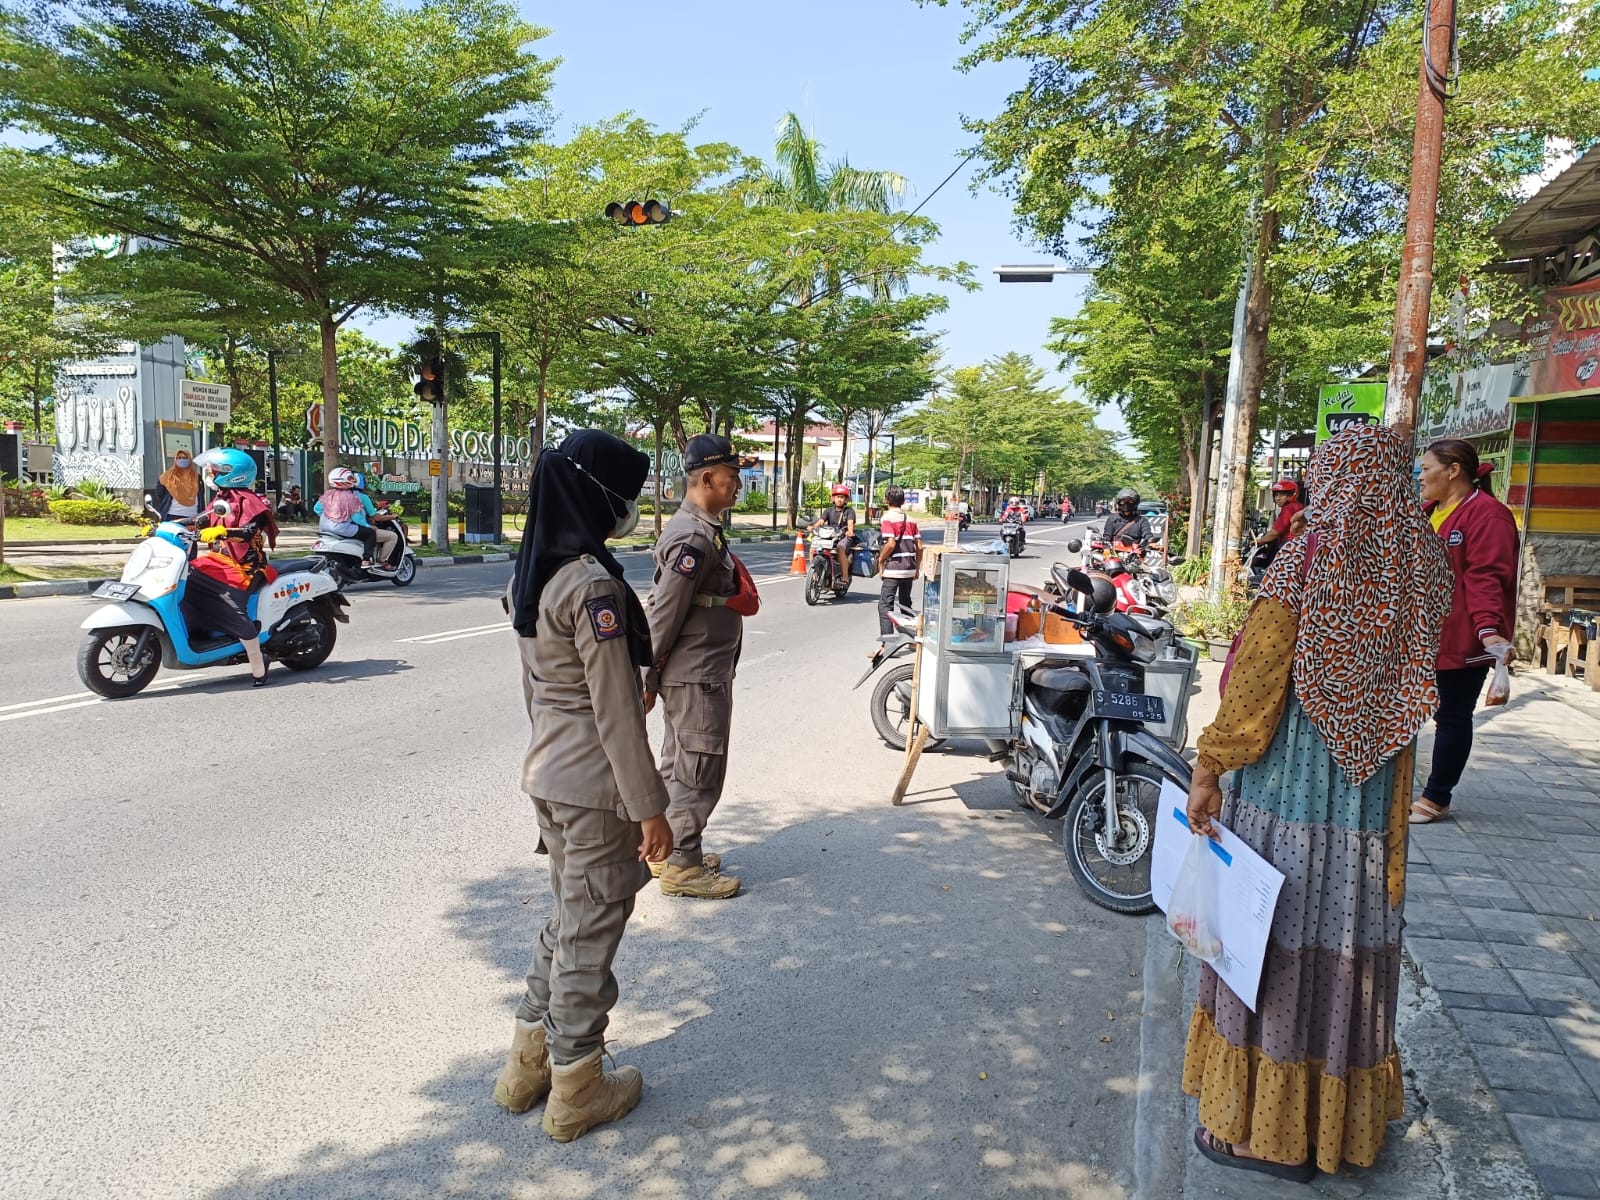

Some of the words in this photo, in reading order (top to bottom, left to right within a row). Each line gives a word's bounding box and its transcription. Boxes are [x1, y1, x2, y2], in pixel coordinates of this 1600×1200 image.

[1323, 387, 1351, 408] Kedai
[338, 413, 401, 451] RSUD
[1097, 692, 1104, 703] S
[1111, 693, 1138, 707] 5286
